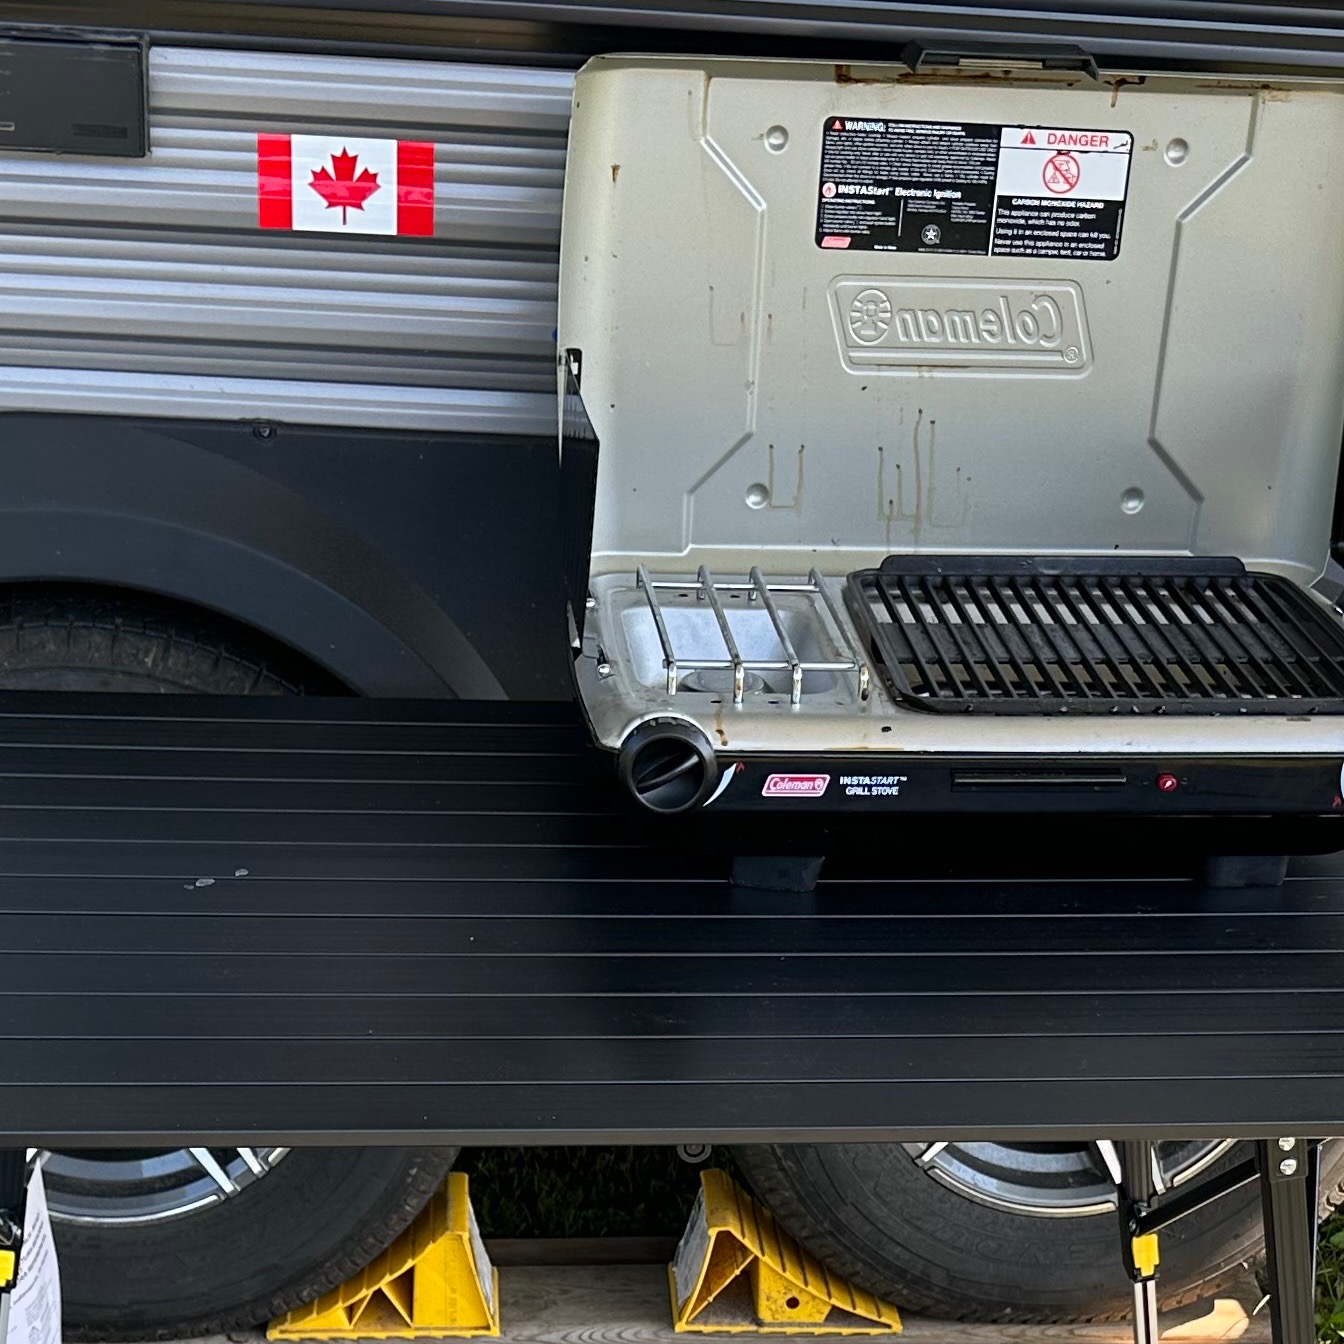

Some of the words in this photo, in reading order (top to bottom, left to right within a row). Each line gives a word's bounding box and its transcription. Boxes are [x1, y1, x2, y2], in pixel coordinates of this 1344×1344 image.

[1047, 133, 1109, 148] DANGER
[895, 187, 932, 198] Electronic
[769, 777, 814, 792] Coleman
[845, 786, 871, 796] GRILL
[871, 786, 899, 796] STOVE
